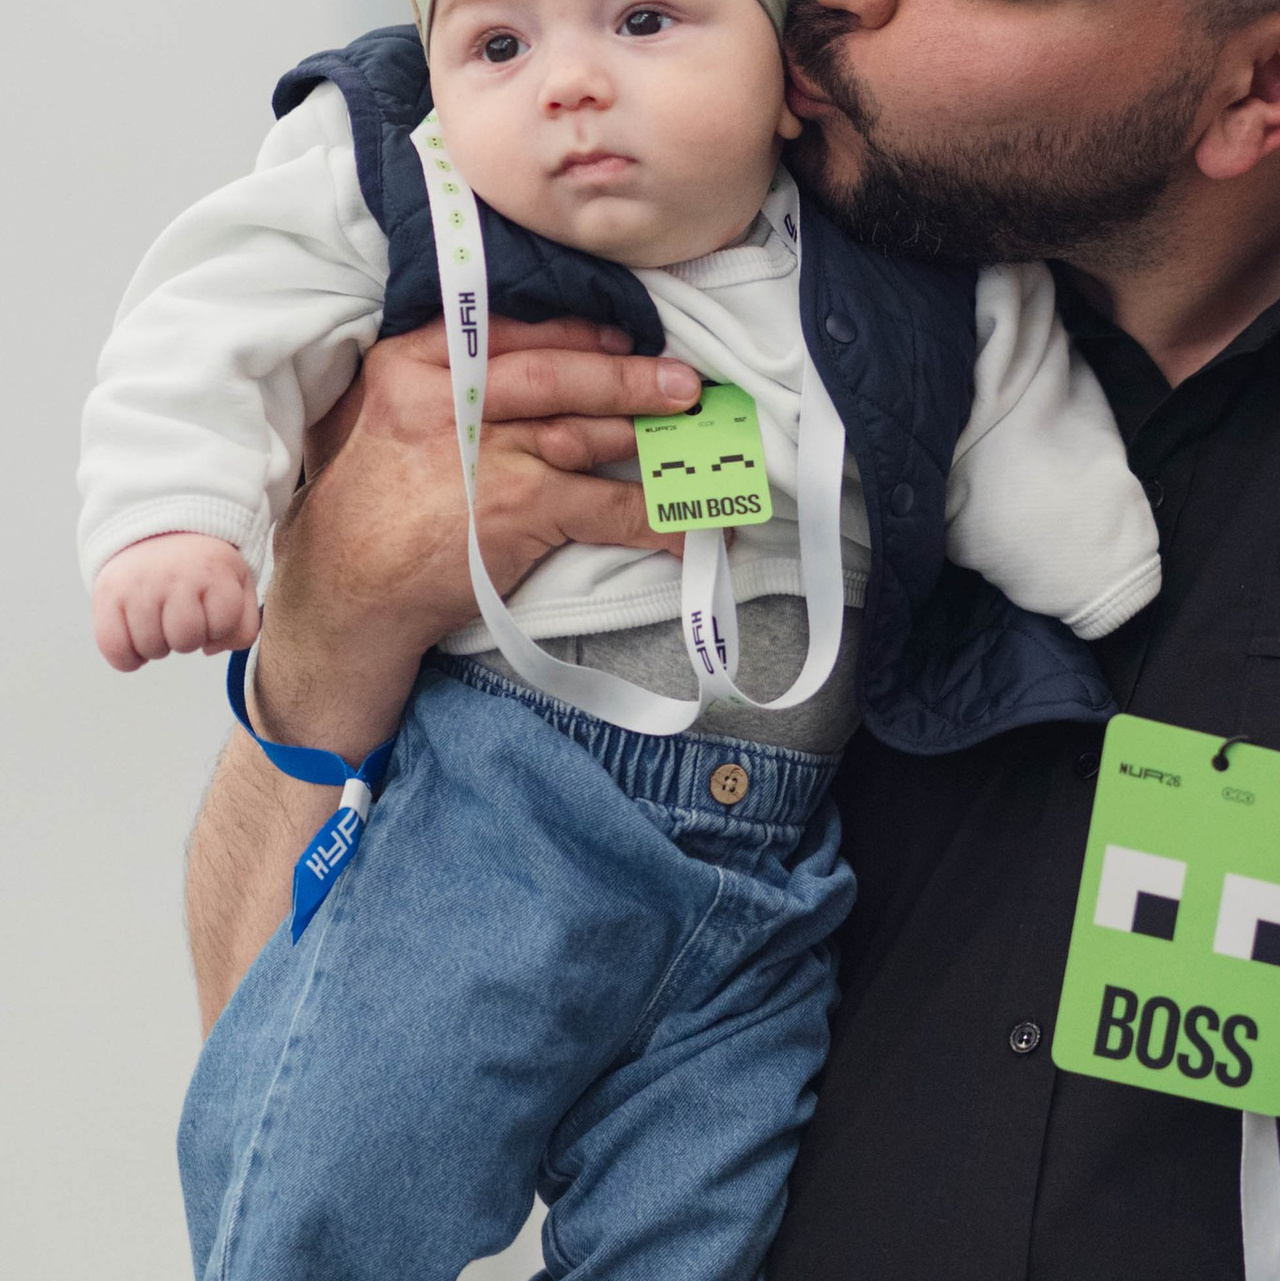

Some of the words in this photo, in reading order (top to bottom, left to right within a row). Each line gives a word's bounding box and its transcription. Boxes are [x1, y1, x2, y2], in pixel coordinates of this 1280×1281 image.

[657, 500, 703, 522] MINI
[706, 494, 762, 518] BOSS
[1093, 984, 1259, 1089] BOSS
